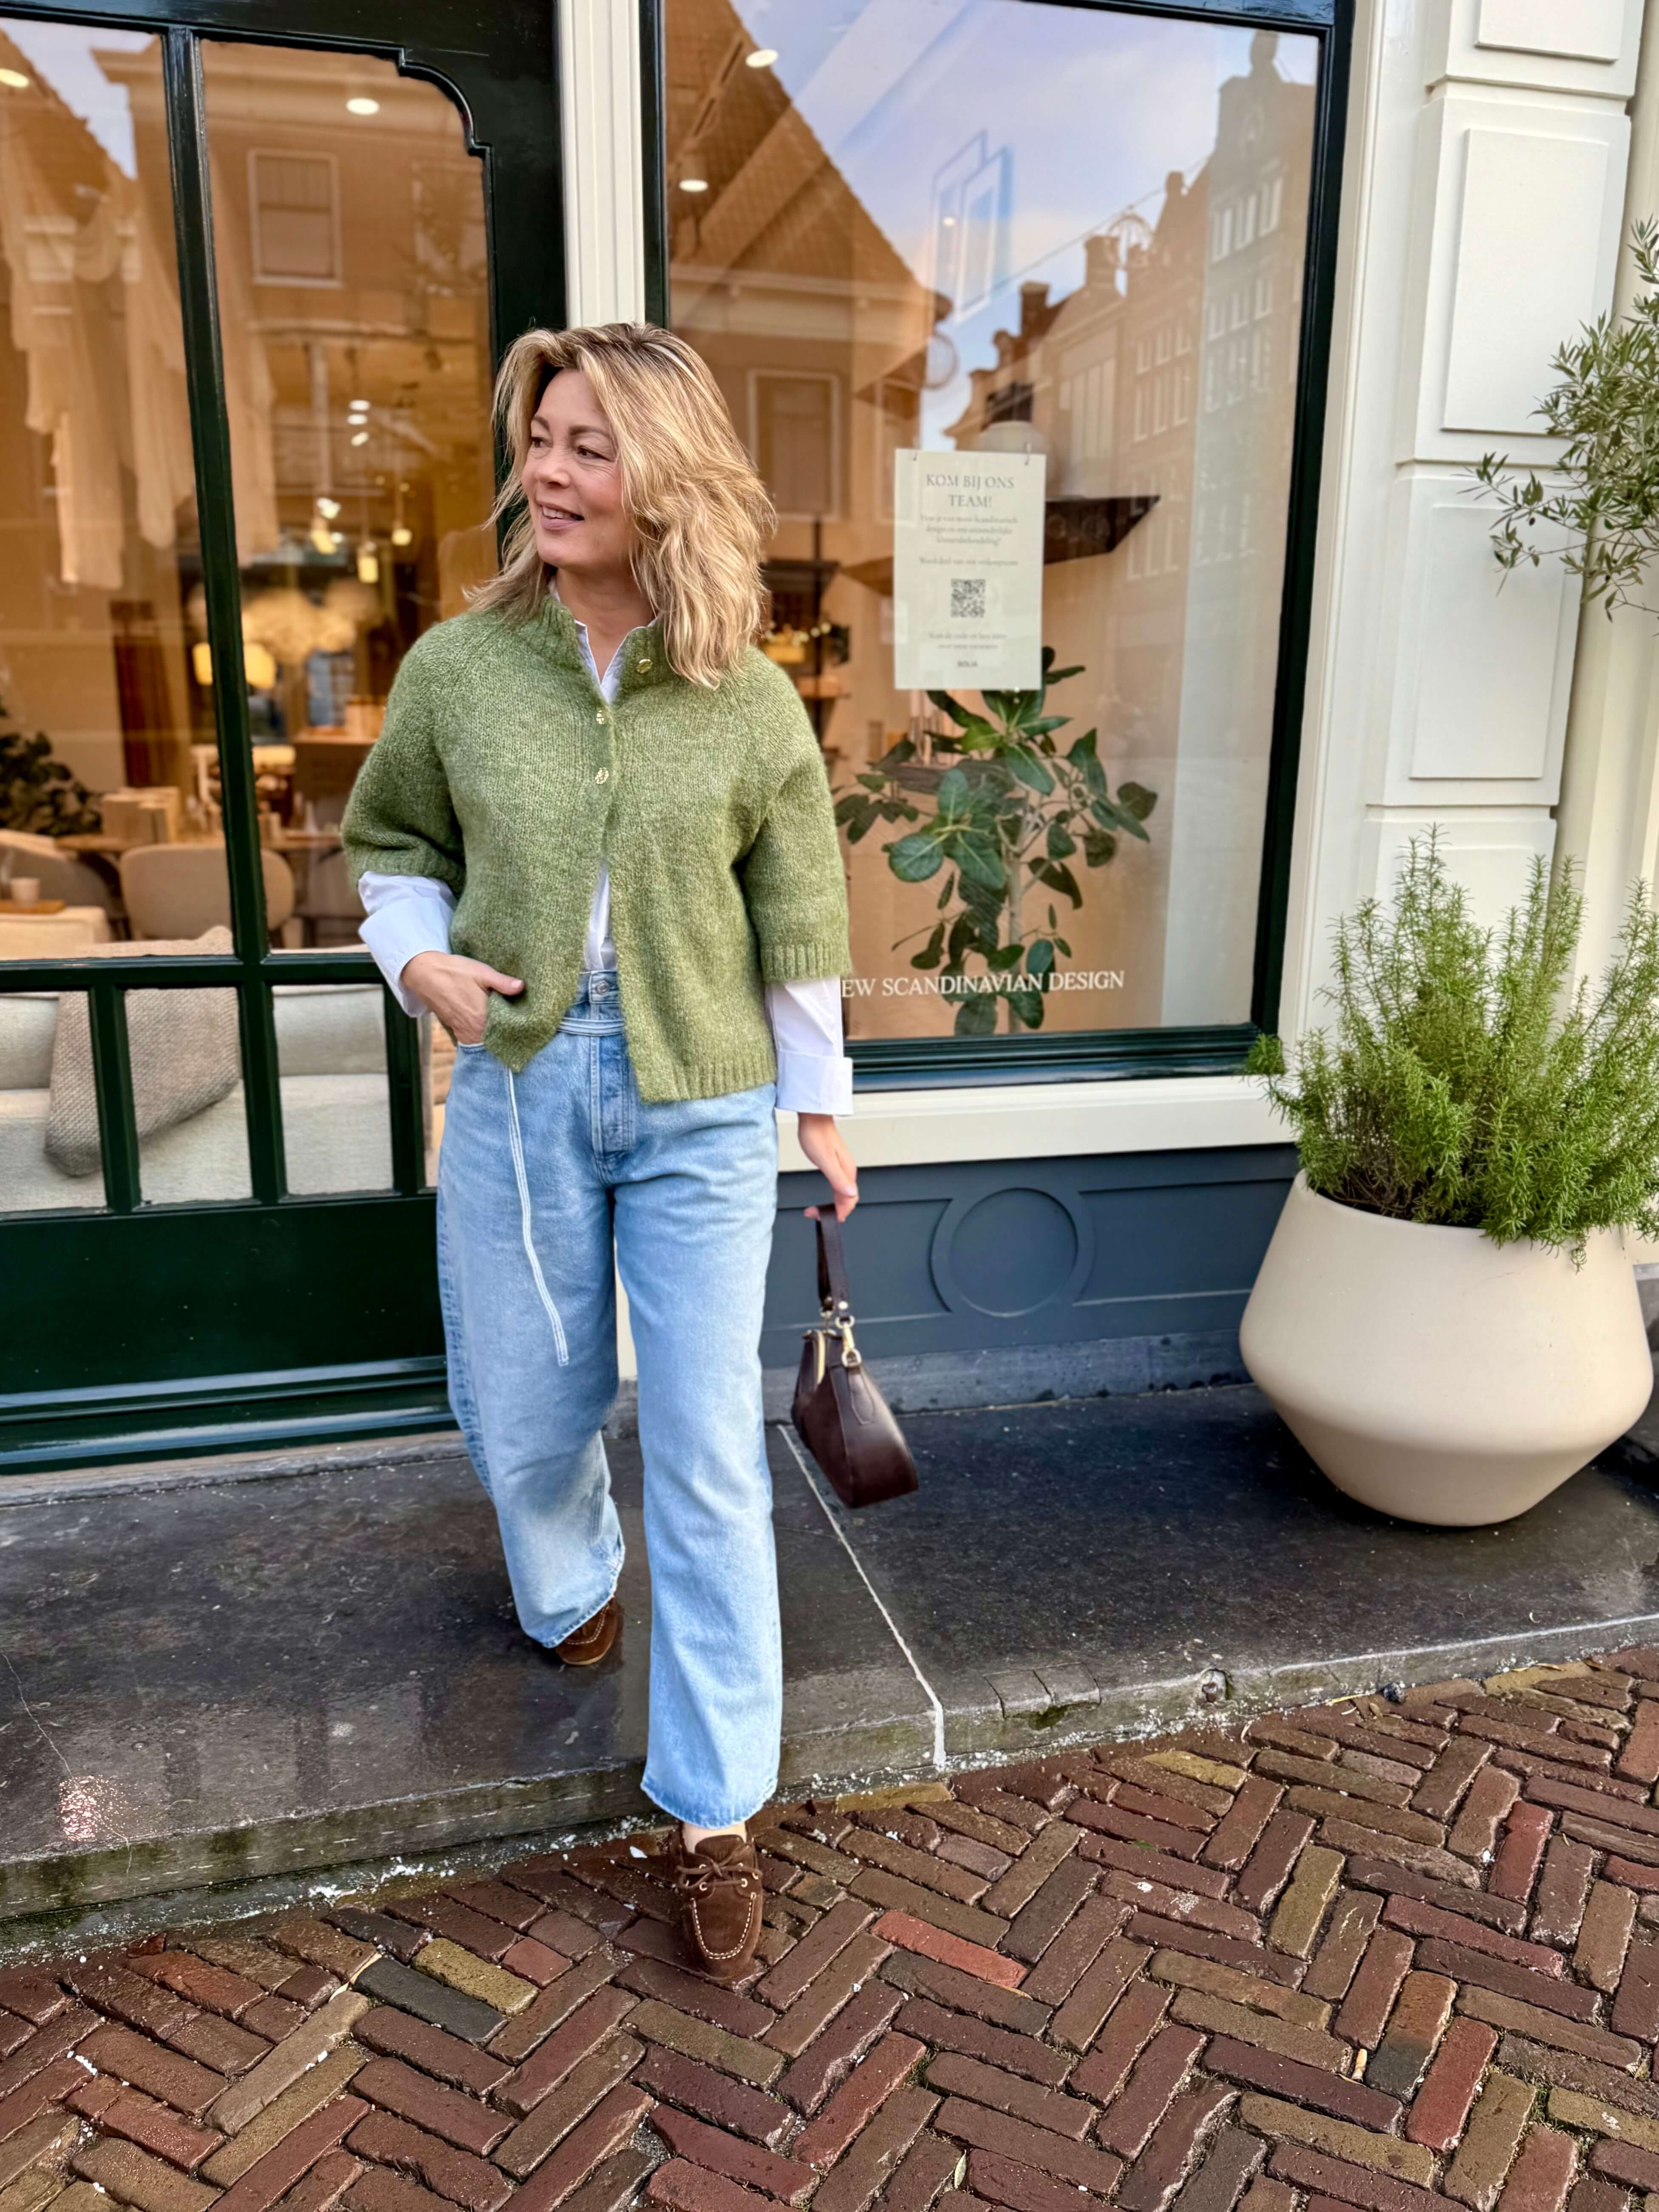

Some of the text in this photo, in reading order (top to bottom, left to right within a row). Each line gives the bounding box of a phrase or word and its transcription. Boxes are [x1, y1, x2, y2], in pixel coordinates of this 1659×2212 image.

[926, 474, 1015, 490] KOM BIJ ONS
[948, 494, 992, 507] TEAM!
[841, 969, 1126, 997] EW SCANDINAVIAN DESIGN
